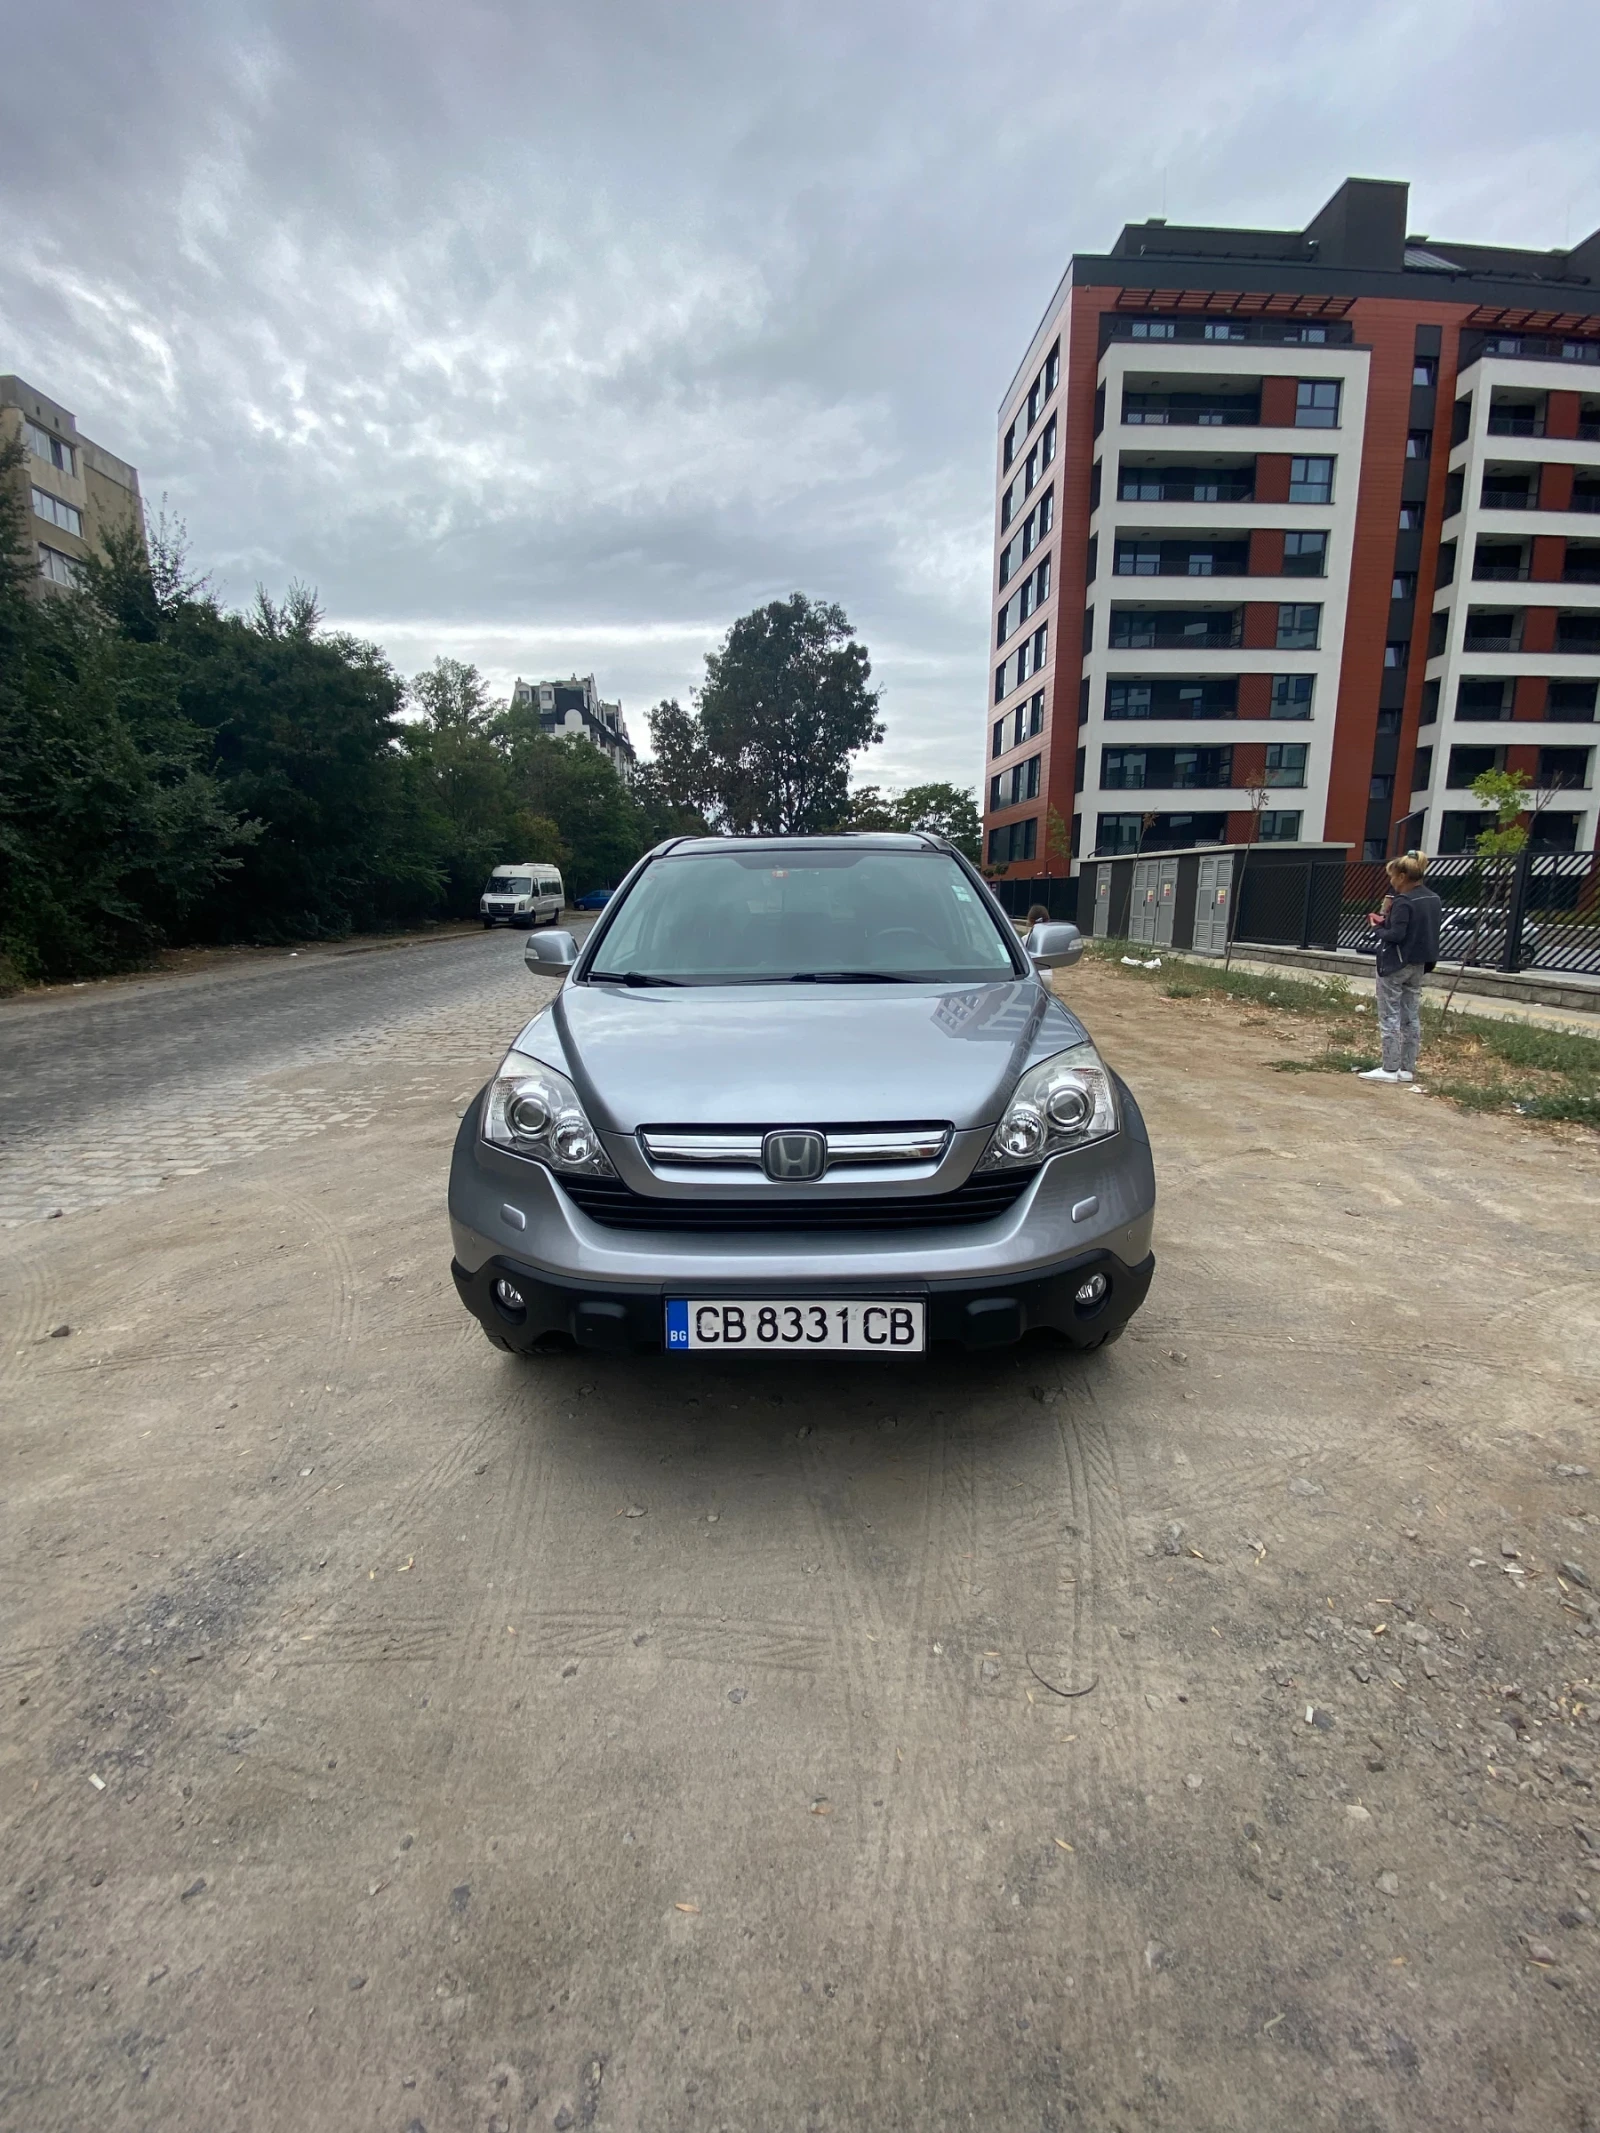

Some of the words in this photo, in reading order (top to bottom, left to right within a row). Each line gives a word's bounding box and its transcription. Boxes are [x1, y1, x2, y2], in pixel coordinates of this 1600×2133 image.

[670, 1330, 687, 1342] BG
[696, 1306, 747, 1343] CB
[757, 1306, 849, 1344] 8331
[863, 1307, 915, 1345] CB
